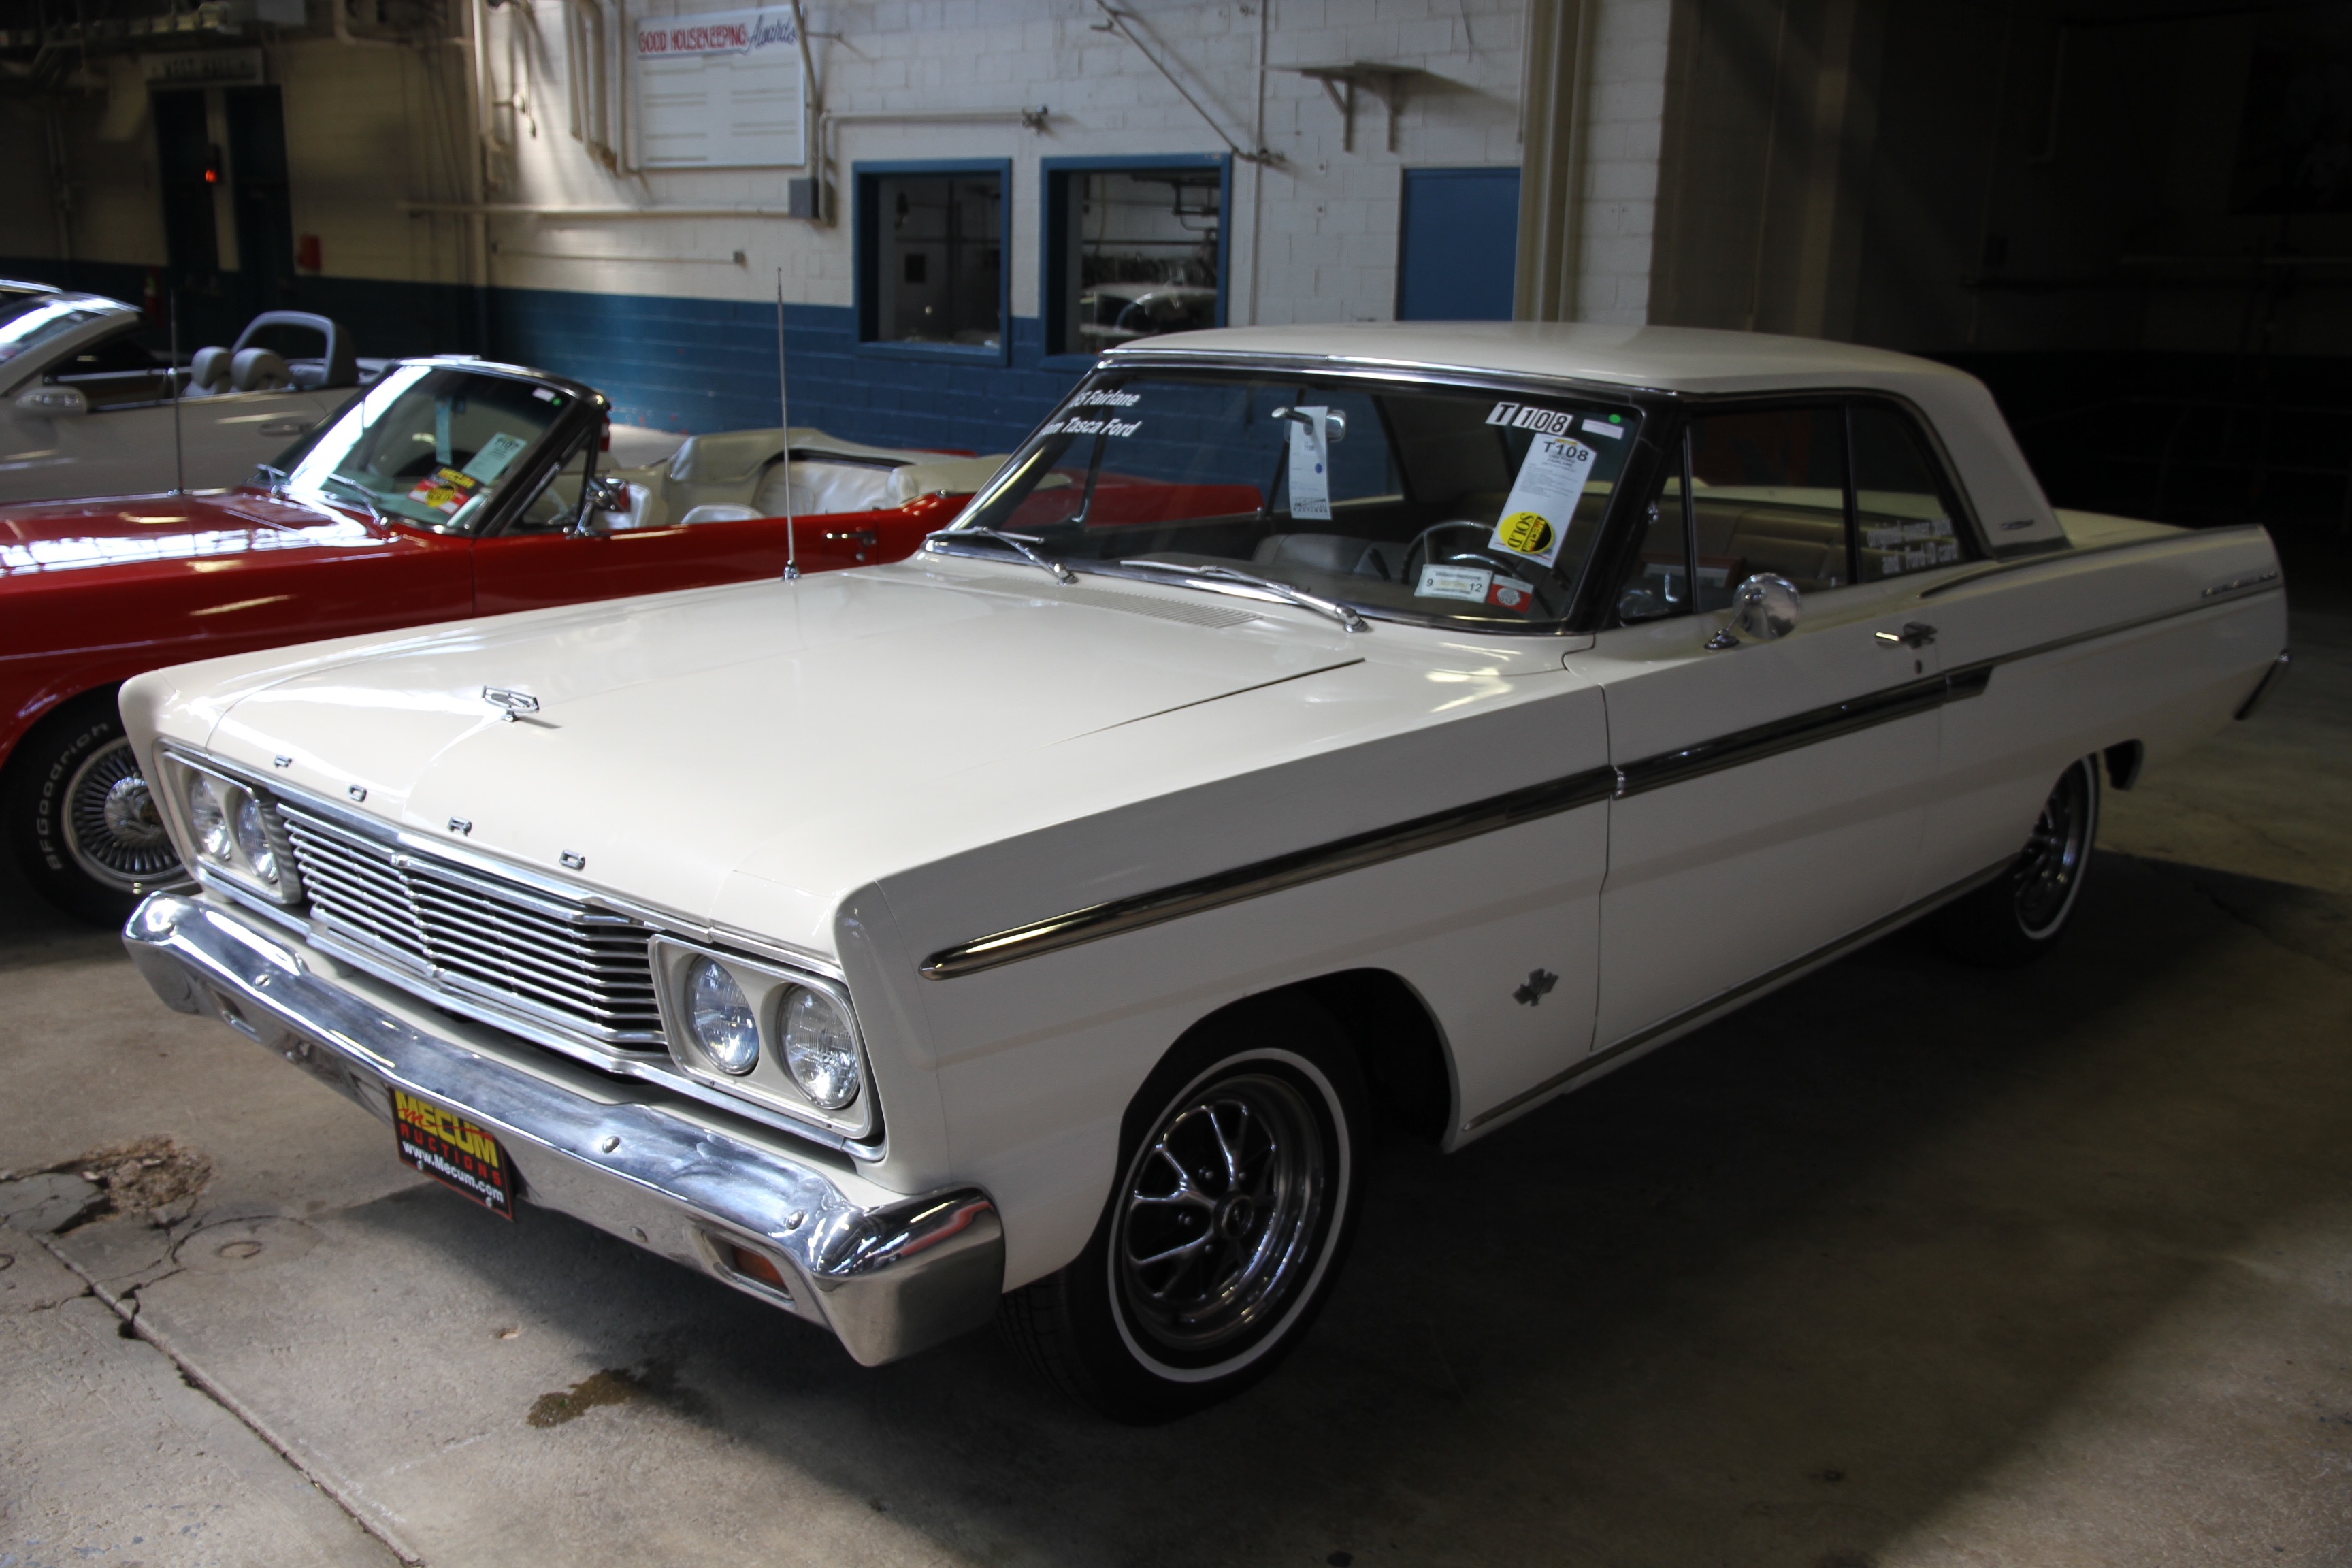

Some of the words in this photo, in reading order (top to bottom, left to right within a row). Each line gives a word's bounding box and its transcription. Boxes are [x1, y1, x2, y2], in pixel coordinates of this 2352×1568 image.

[638, 29, 667, 54] GOOD
[670, 23, 749, 51] HOUSEKEEPING
[1083, 389, 1142, 407] Fairlane
[1060, 416, 1105, 434] Tasca
[1099, 418, 1143, 438] Ford
[1543, 441, 1588, 462] T108
[1507, 512, 1535, 548] SOLD
[1426, 578, 1434, 587] 9
[1469, 583, 1482, 592] 12
[36, 722, 110, 871] BFGoodrich
[394, 1090, 500, 1169] MECUM
[399, 1122, 502, 1187] AUCTIONS
[402, 1141, 504, 1203] www.Mecum.com
